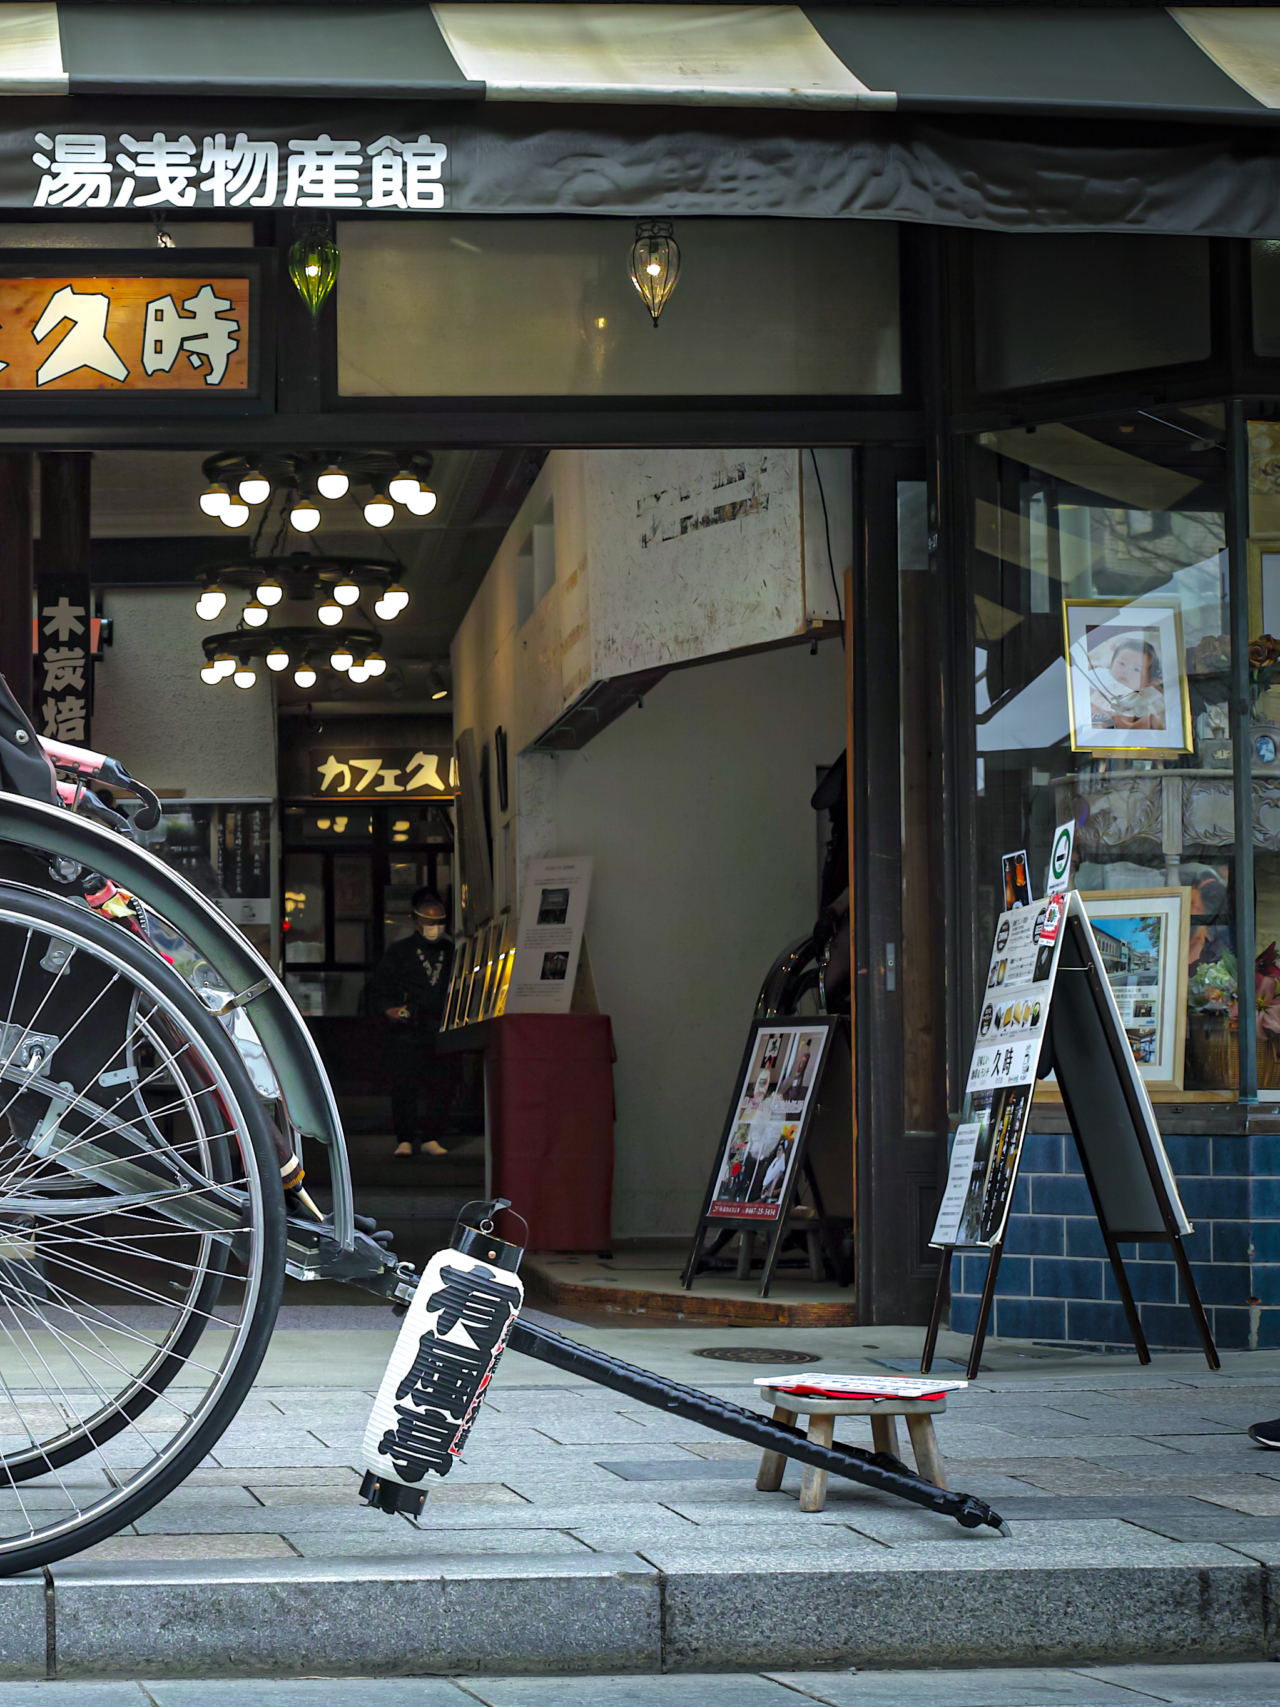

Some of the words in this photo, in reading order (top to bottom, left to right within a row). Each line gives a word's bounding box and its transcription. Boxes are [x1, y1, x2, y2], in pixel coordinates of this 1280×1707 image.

[31, 132, 448, 210] 湯浅物産館
[41, 596, 87, 784] 木炭焙
[991, 1047, 1014, 1077] 久時
